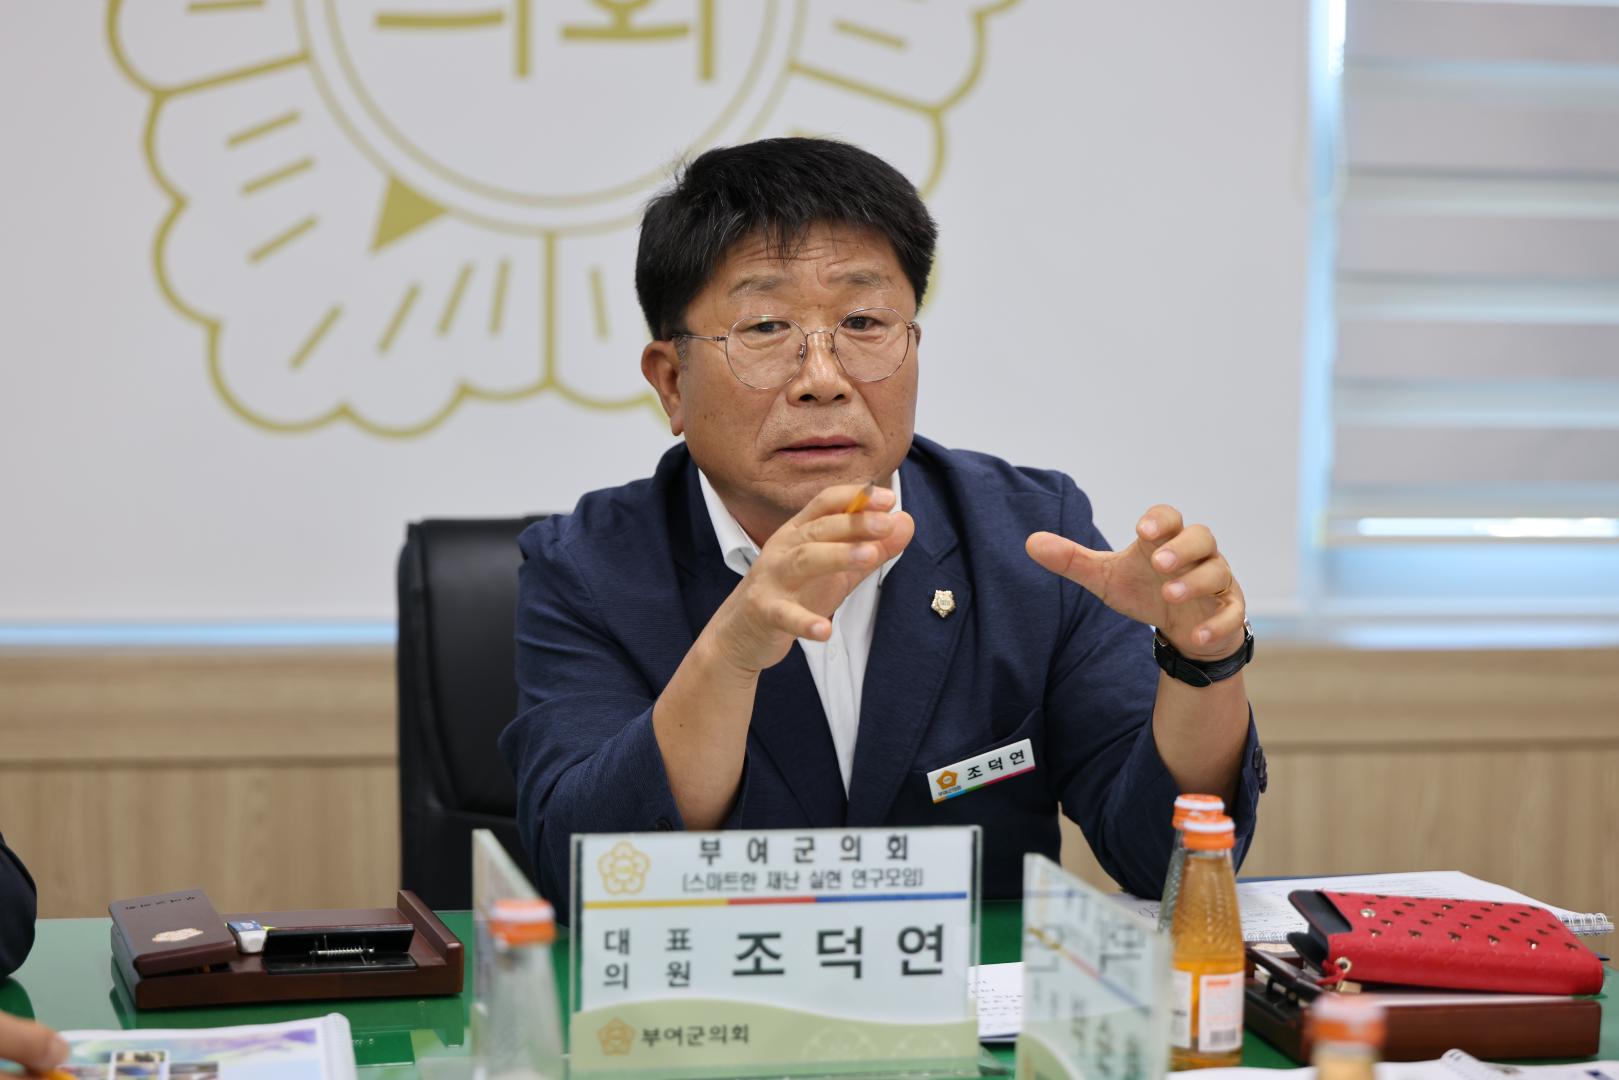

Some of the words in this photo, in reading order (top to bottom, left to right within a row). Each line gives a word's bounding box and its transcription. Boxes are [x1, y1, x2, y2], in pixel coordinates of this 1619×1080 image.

[766, 872, 801, 891] 재난
[809, 869, 842, 890] 실현
[641, 1023, 749, 1048] 부여군의회
